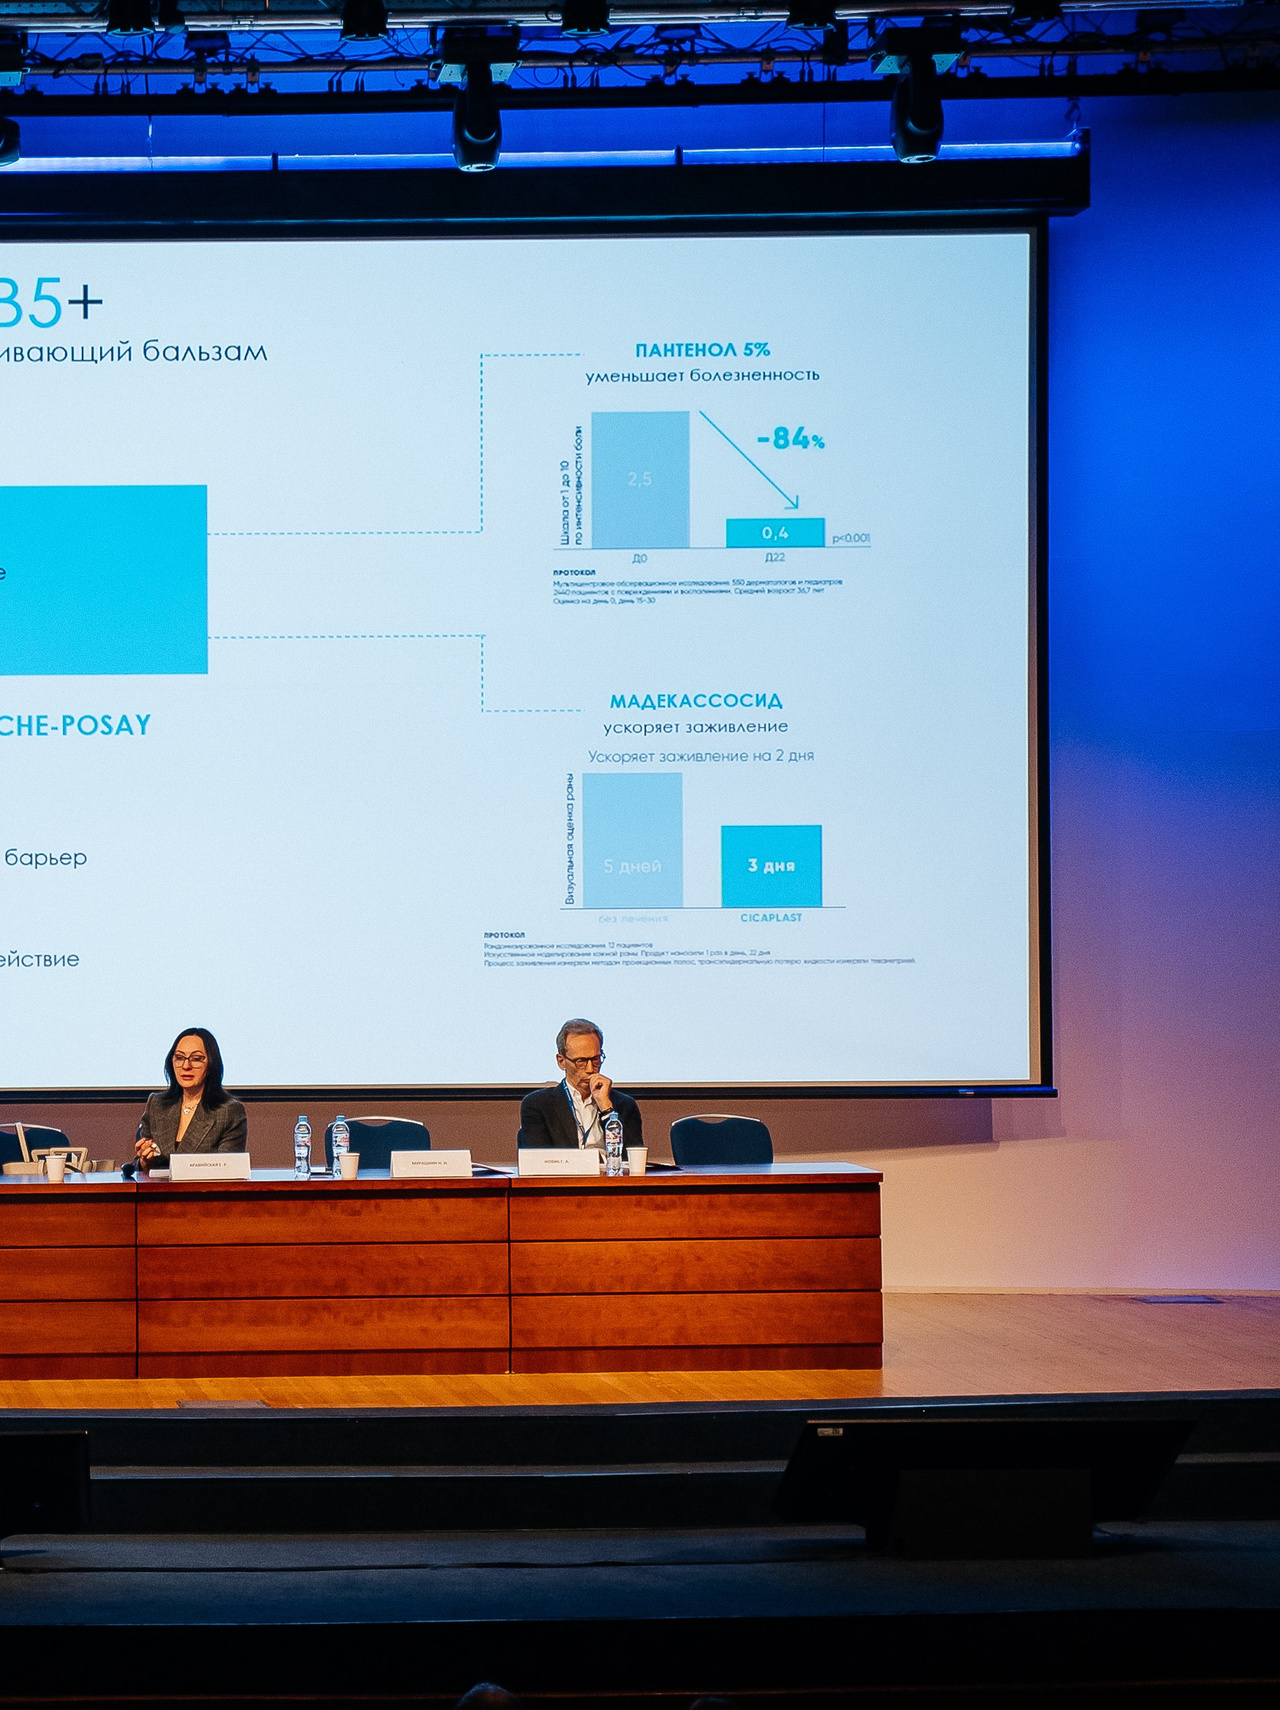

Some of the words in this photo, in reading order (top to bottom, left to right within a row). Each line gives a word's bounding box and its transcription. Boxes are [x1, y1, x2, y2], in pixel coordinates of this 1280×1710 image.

[143, 339, 267, 361] бальзам
[636, 342, 737, 357] ПАНТЕНОЛ
[743, 342, 771, 357] 5%
[586, 372, 684, 385] уменьшает
[690, 369, 820, 382] болезненность
[757, 426, 825, 449] -84%
[627, 471, 653, 488] 2,5
[560, 510, 569, 546] Шкала
[762, 526, 789, 541] 0,4
[610, 693, 783, 710] МАДЕКАССОСИД
[603, 724, 679, 736] ускоряет
[685, 721, 789, 734] заживление
[588, 749, 655, 766] Ускоряет
[660, 749, 749, 763] заживление
[753, 750, 772, 762] на
[776, 748, 785, 762] 2
[788, 749, 815, 764] дня
[567, 803, 575, 842] оценка
[5, 848, 87, 869] барьер
[604, 859, 614, 874] 5
[619, 857, 663, 875] дней
[748, 858, 758, 872] 3
[763, 859, 796, 875] дня
[565, 844, 576, 906] Визуальная
[740, 913, 803, 923] CICAPLAST
[484, 931, 526, 939] ПРОТОКОЛ
